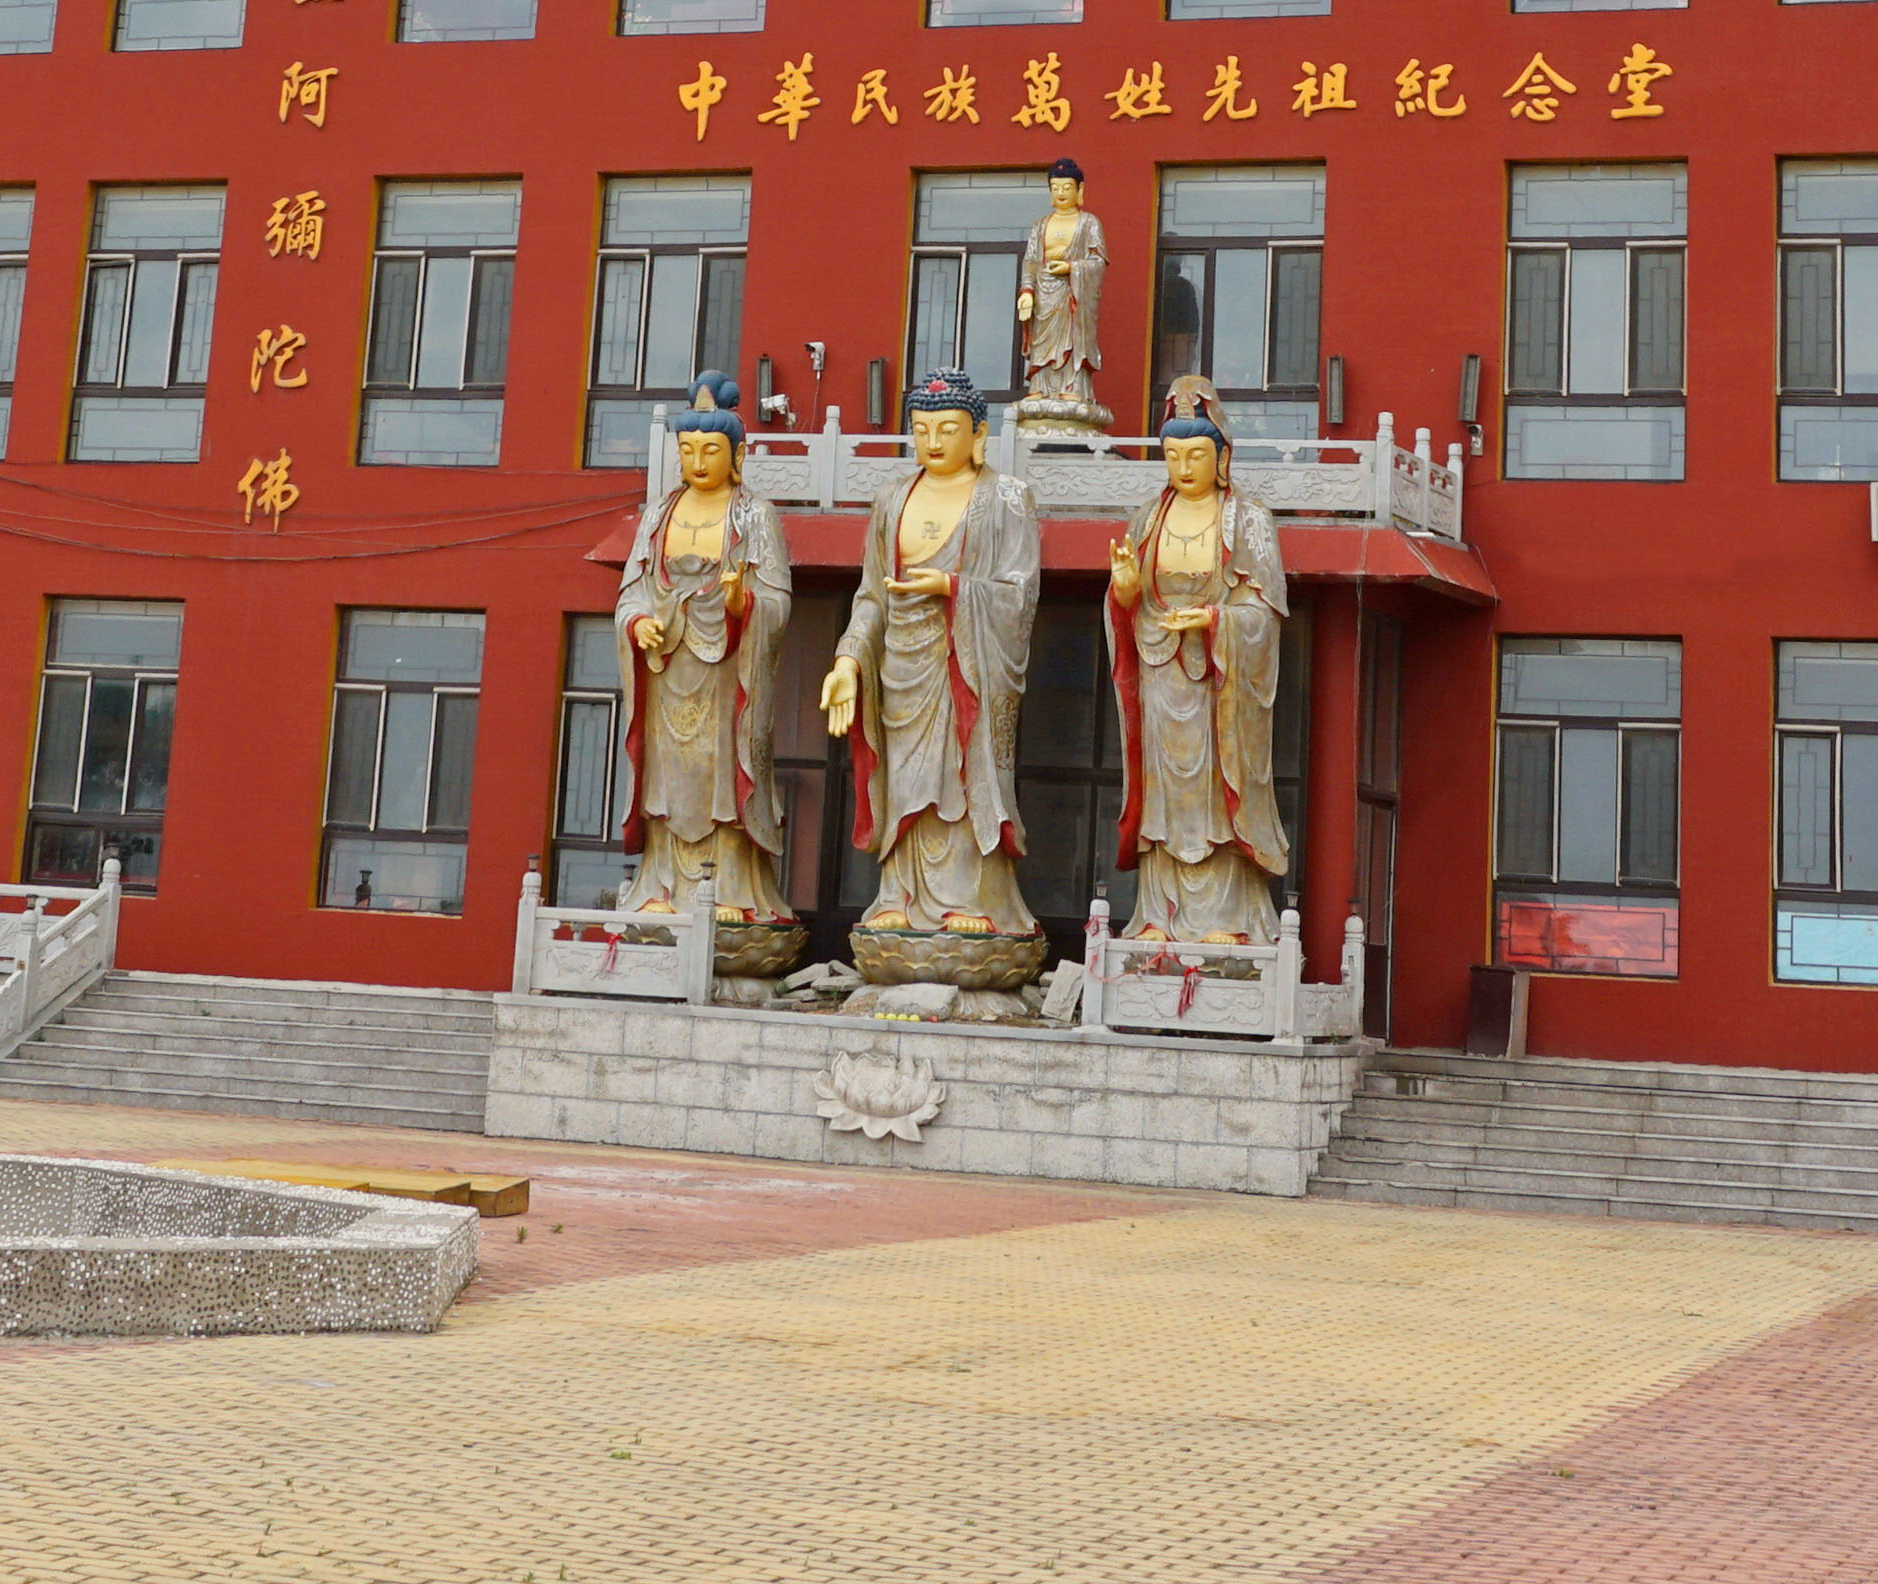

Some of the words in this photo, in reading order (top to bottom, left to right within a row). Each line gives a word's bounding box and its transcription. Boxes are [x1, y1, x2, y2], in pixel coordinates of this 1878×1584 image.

[676, 43, 1675, 143] 中華民族萬姓先祖紀念堂
